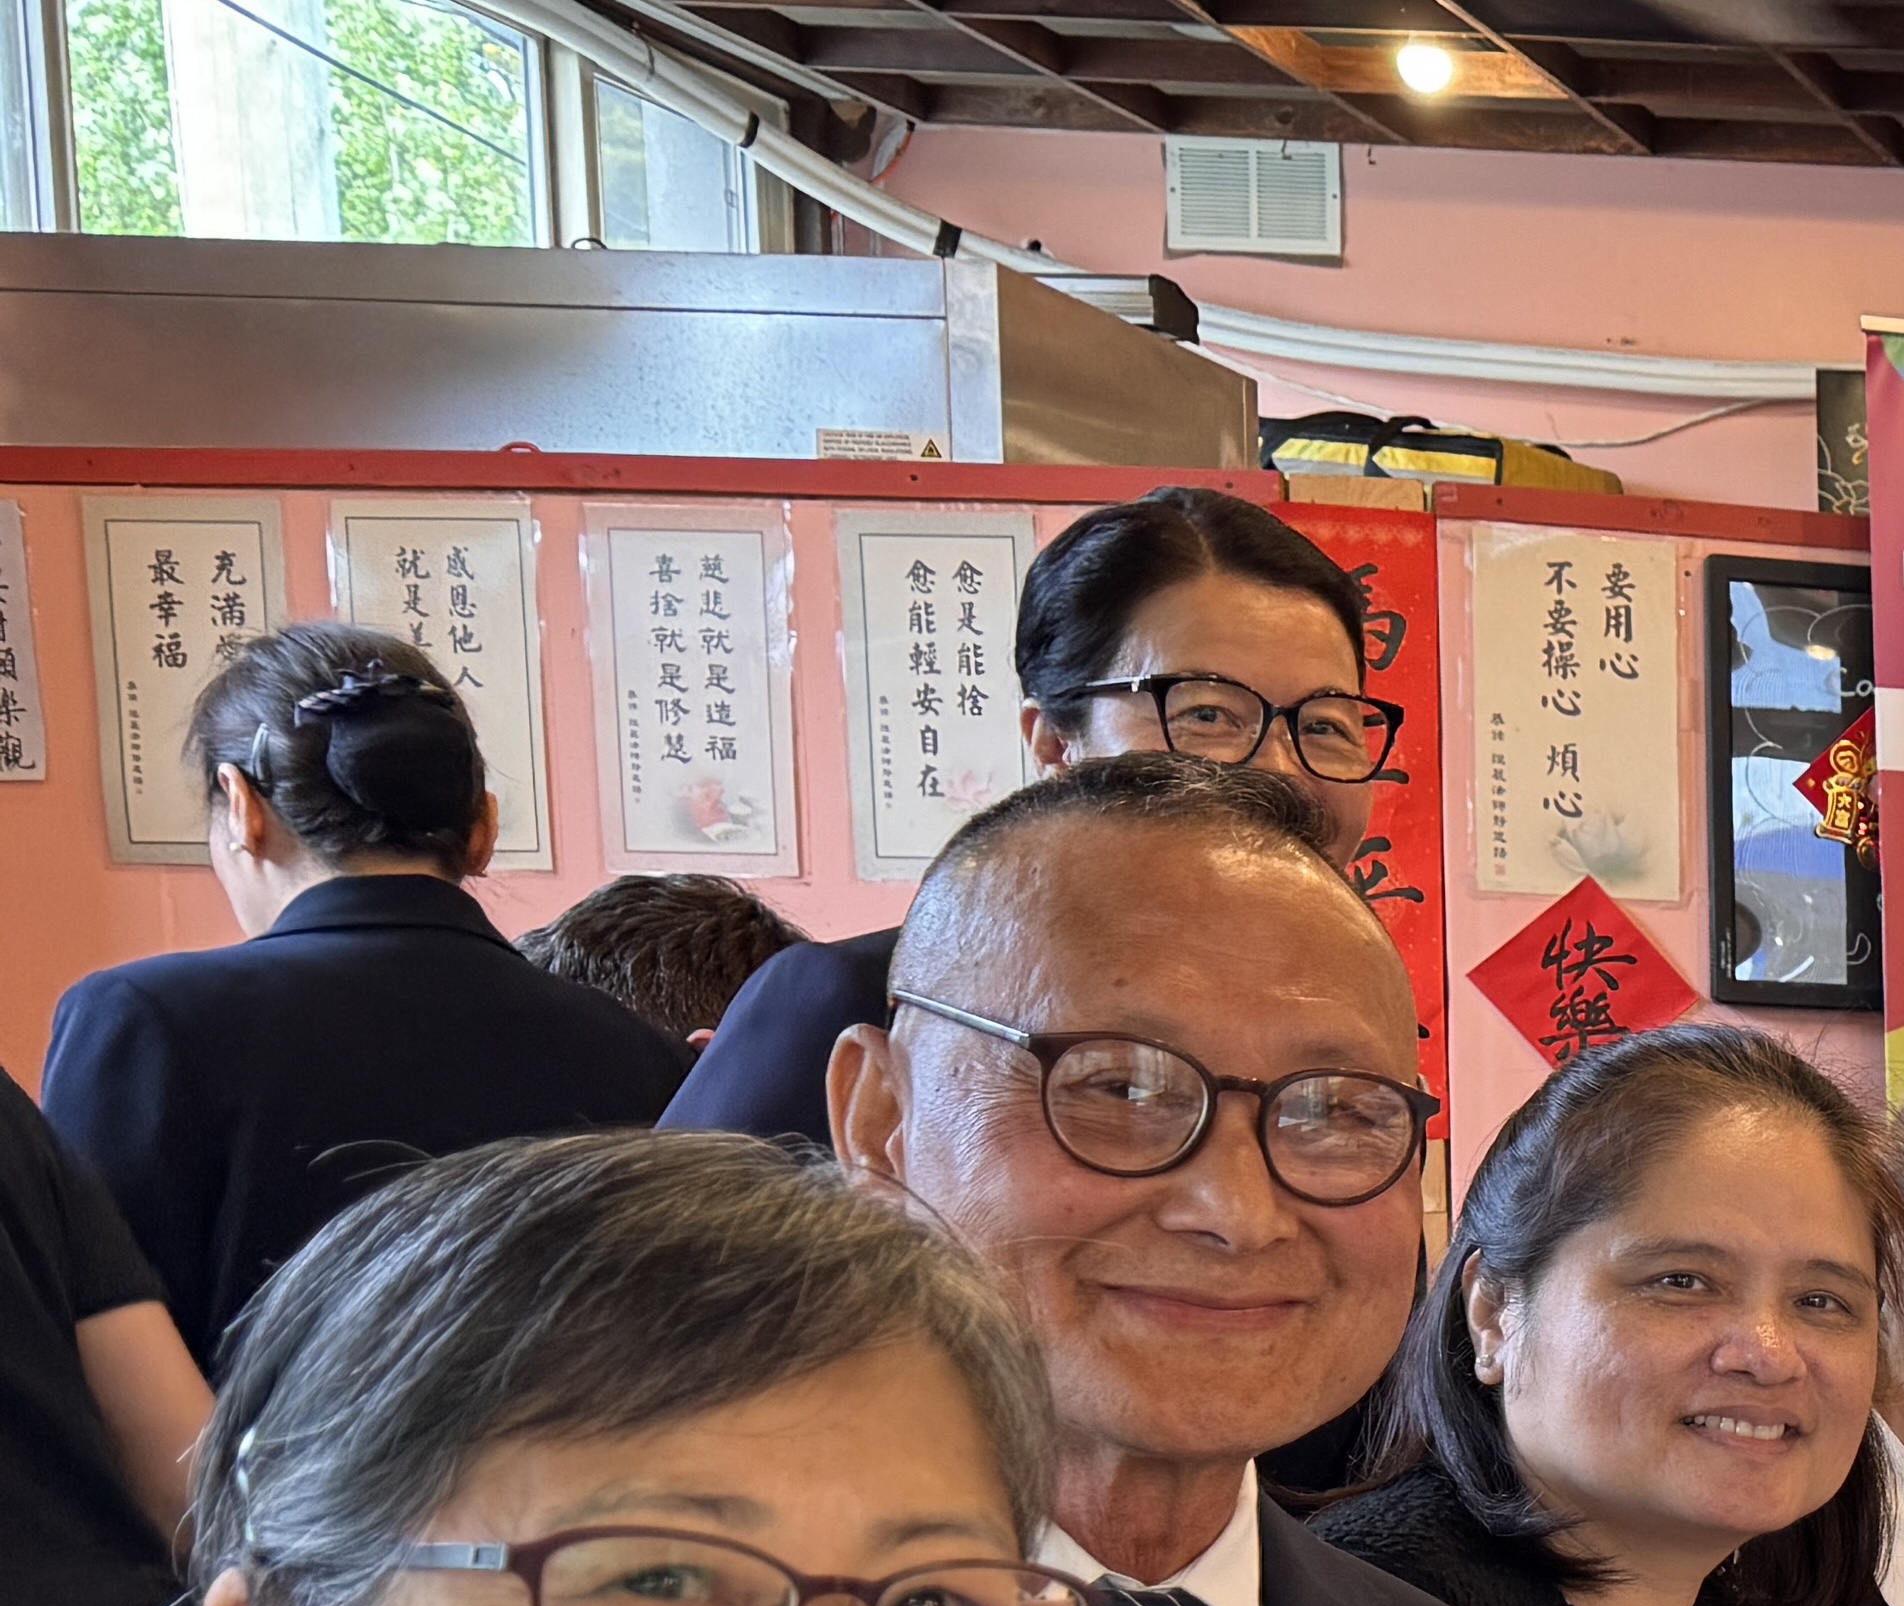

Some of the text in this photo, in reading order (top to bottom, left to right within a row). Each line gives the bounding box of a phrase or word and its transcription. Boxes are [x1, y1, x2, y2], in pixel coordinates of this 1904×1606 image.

[148, 550, 187, 668] 最幸福
[447, 546, 483, 687] 感恩他人
[649, 553, 692, 764] 喜捨就是修慧
[698, 554, 737, 761] 慈悲就是造福
[905, 559, 945, 797] 愈能輕安自在
[952, 559, 990, 716] 愈是能捨
[1600, 562, 1639, 679] 要用心
[1541, 561, 1583, 818] 不要操心 煩心
[1538, 917, 1638, 1061] 快樂
